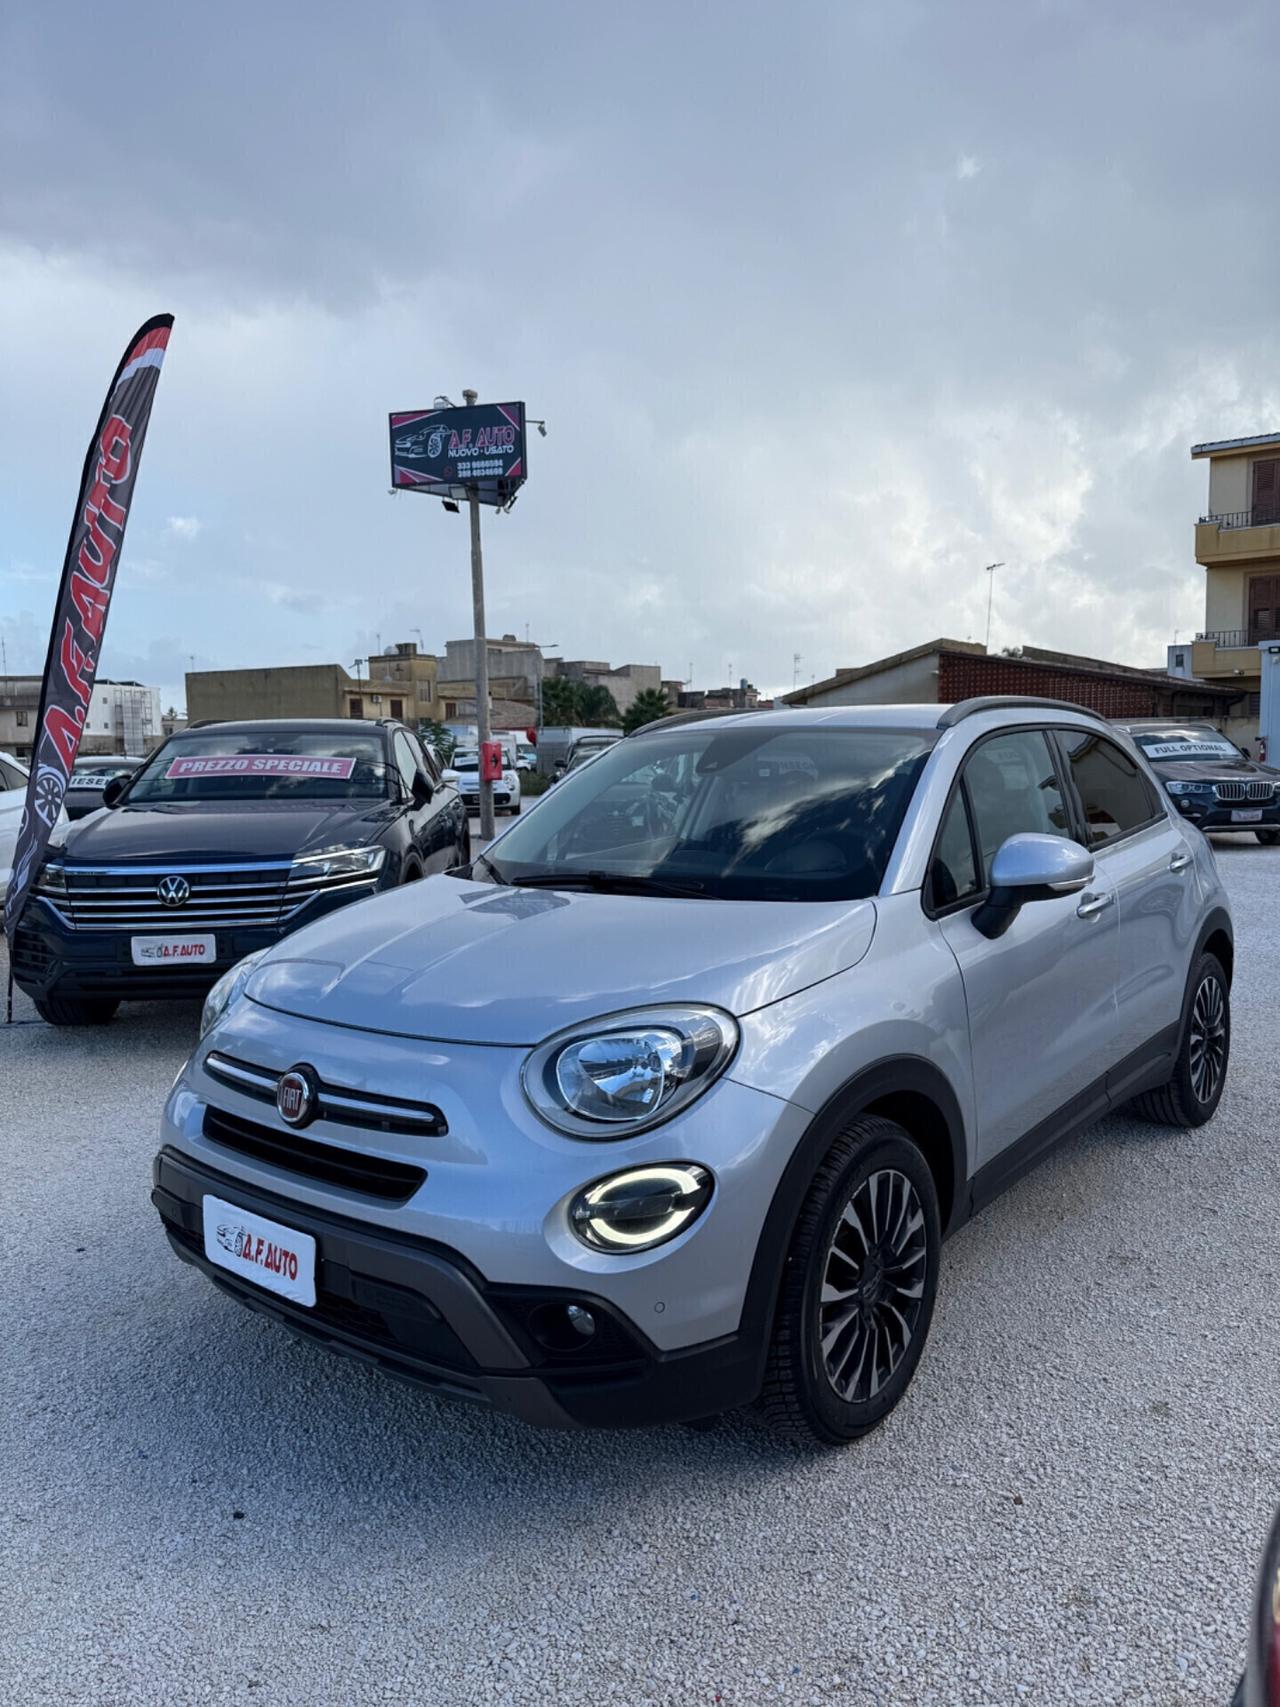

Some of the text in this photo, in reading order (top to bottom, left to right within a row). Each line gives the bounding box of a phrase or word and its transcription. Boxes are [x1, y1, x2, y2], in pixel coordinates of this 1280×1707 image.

[447, 445, 514, 458] NUOVO USATO
[1154, 743, 1227, 754] FULL OPTIONAL
[178, 758, 343, 774] PREZZO SPECIALE
